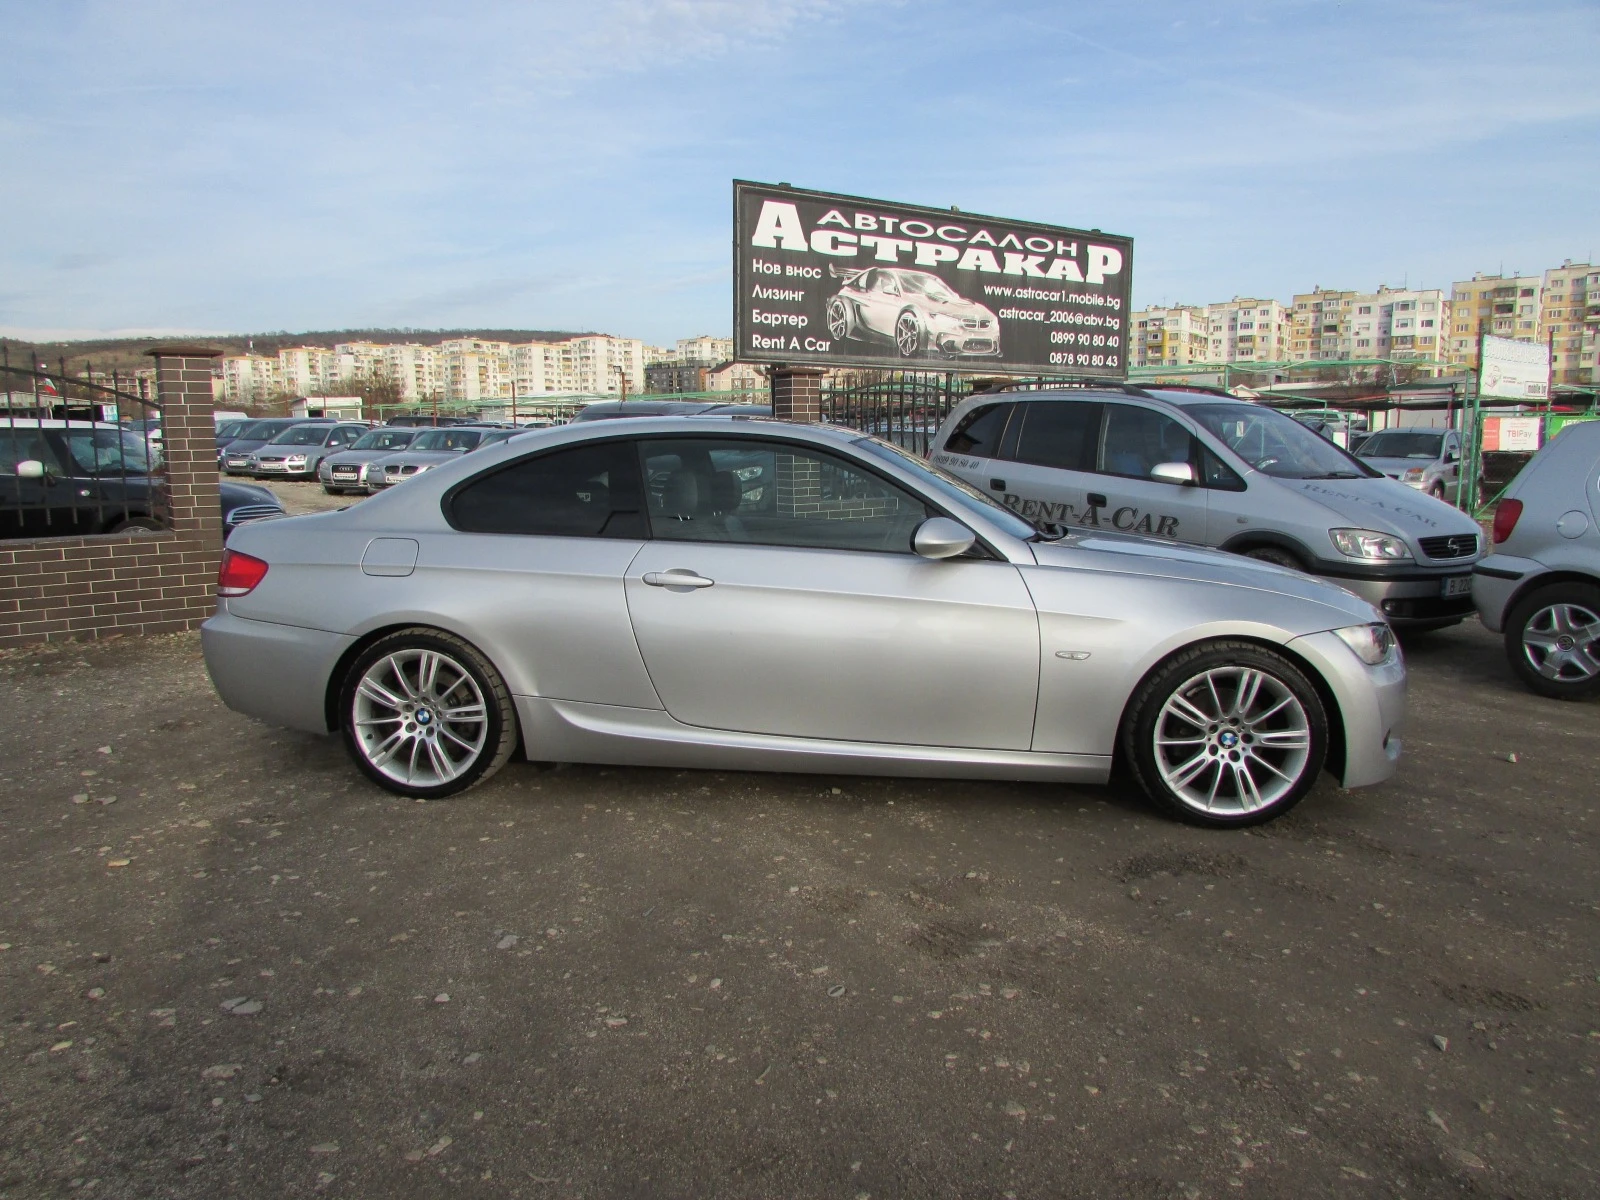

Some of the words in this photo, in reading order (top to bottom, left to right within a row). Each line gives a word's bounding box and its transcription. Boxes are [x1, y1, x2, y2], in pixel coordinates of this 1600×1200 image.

[752, 200, 1122, 284] АСТРАКАР
[816, 209, 1077, 257] АВТОСАЛОН
[752, 258, 781, 275] Нов
[752, 284, 805, 302] Лизинг
[984, 284, 1120, 310] www.astracar1.mobile.bg
[752, 309, 808, 328] Бартер
[998, 307, 1120, 330] astracar_2006@abv.bg
[752, 334, 785, 350] Rent
[789, 336, 800, 350] A
[804, 337, 831, 352] Car
[1050, 331, 1075, 345] 0899
[1077, 333, 1090, 346] 90
[1092, 334, 1105, 347] 80
[1107, 335, 1119, 348] 40
[1049, 352, 1074, 365] 0878
[1077, 353, 1089, 366] 90
[1091, 354, 1104, 367] 80
[1106, 355, 1118, 368] 43
[1002, 493, 1180, 537] RENT-A-CAR
